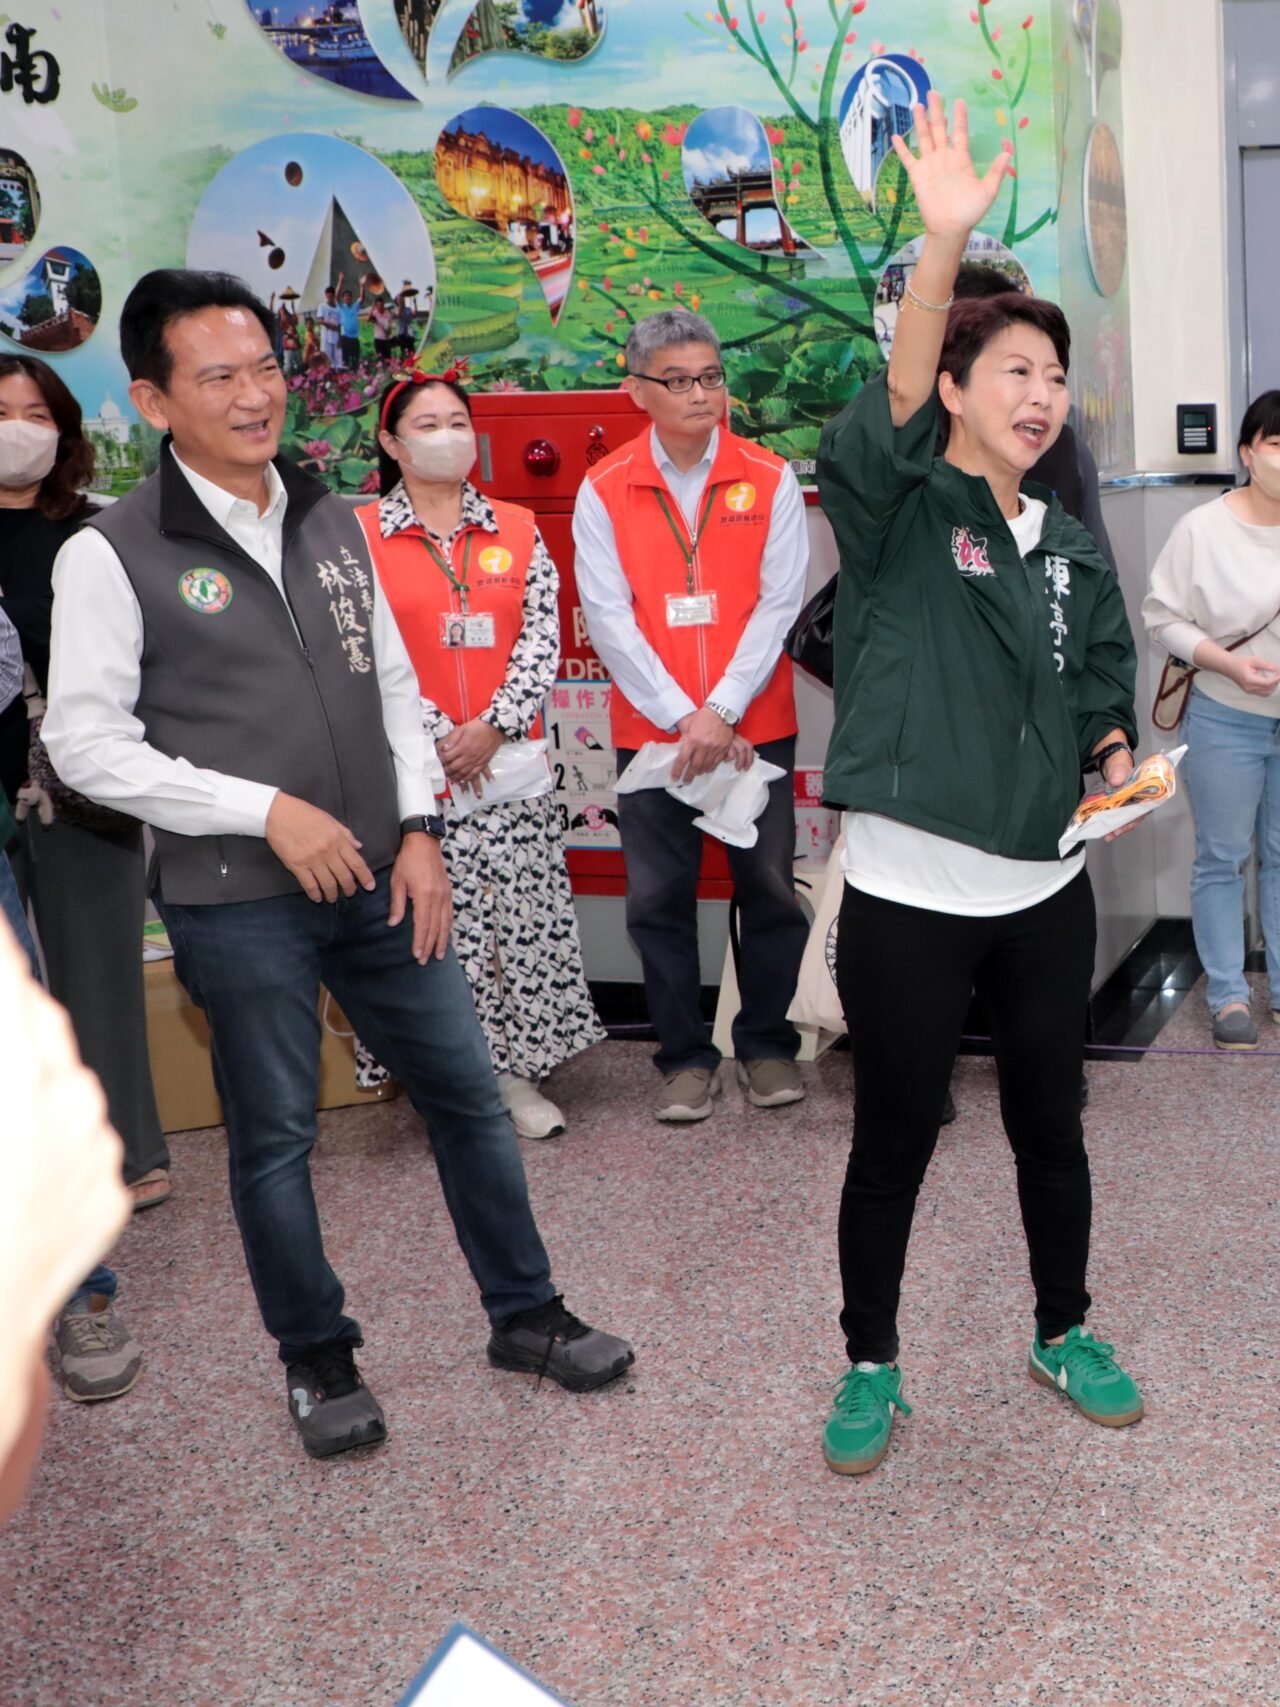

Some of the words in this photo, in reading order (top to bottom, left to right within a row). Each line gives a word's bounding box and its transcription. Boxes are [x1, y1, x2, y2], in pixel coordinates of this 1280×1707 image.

[316, 560, 371, 673] 林俊憲
[550, 722, 560, 750] 1
[554, 763, 566, 791] 2
